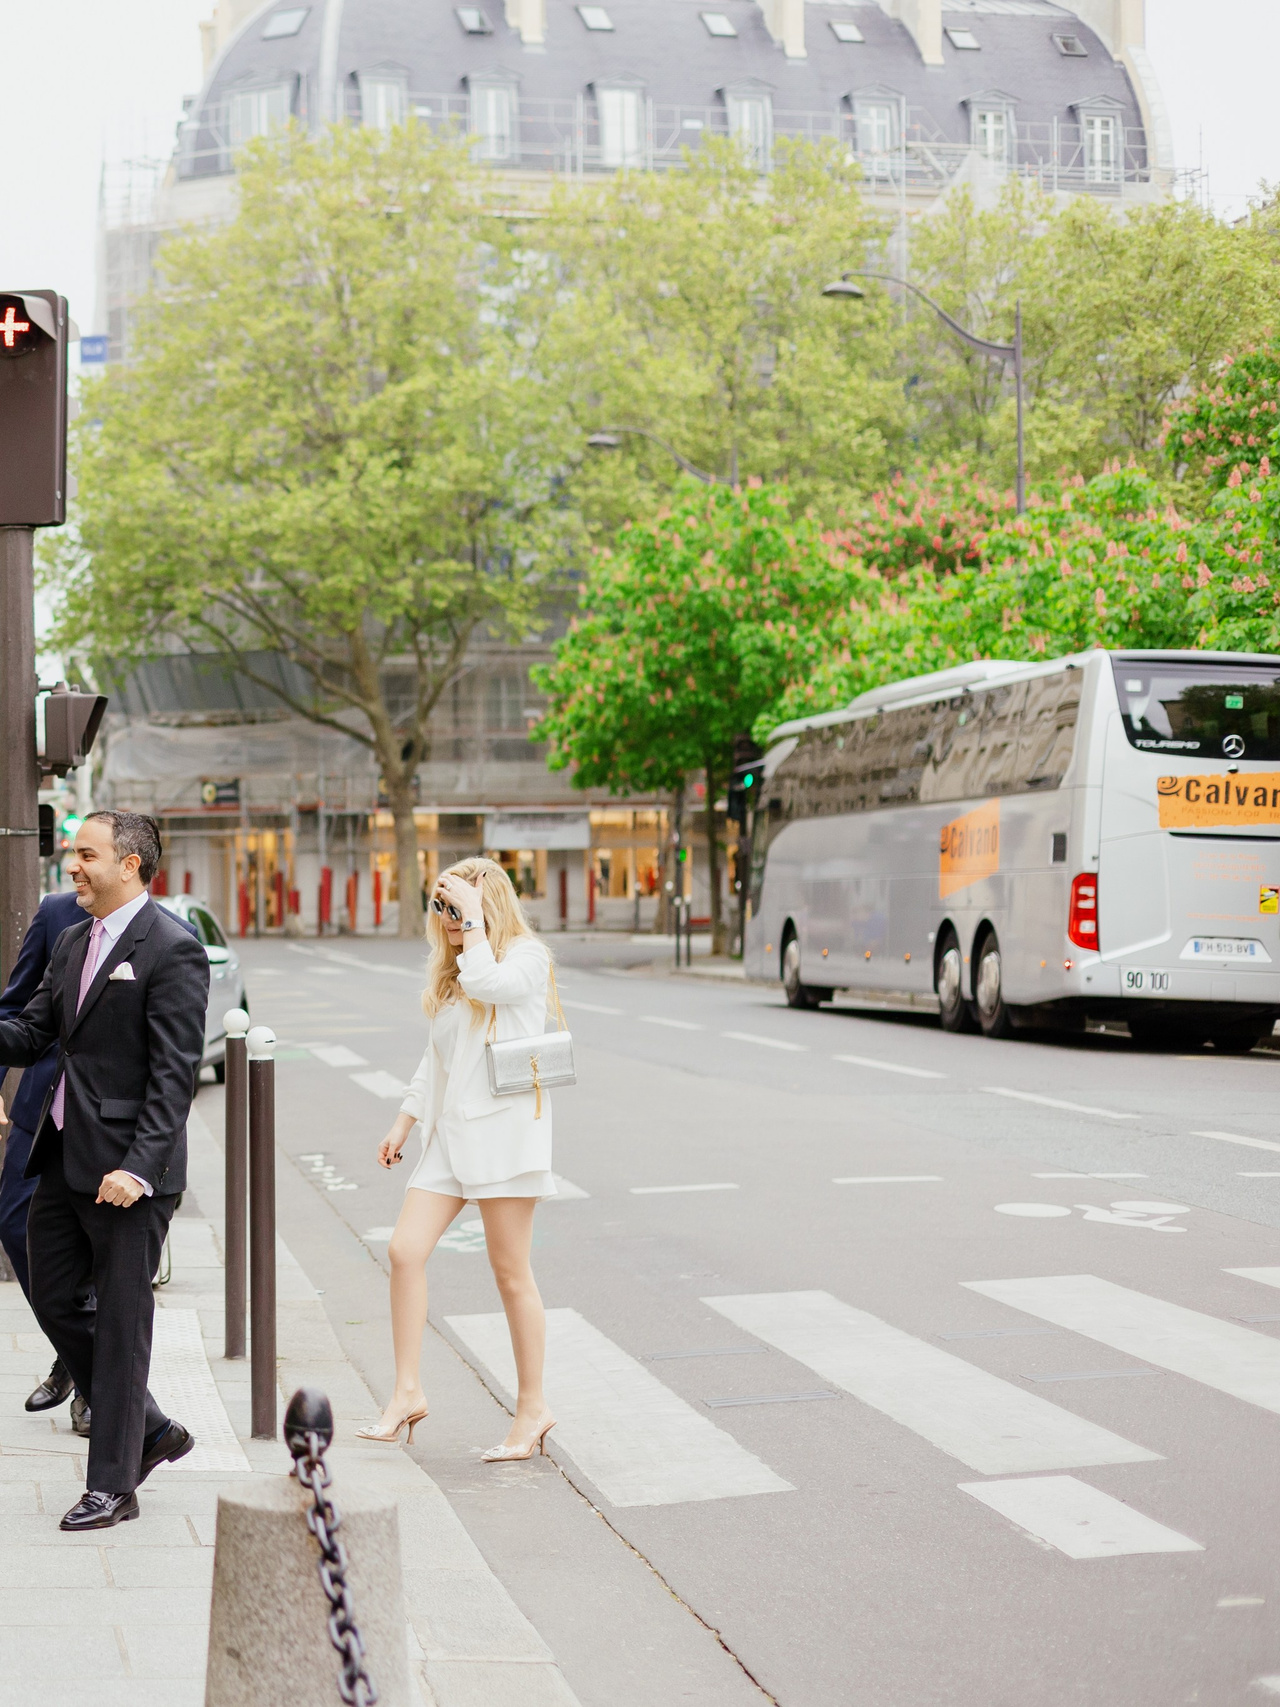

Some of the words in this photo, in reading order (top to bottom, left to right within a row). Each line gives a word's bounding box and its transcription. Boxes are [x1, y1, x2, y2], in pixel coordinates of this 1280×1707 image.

[1237, 809, 1260, 817] FOR
[950, 825, 998, 858] Calvano
[1127, 972, 1143, 989] 90
[1151, 973, 1169, 991] 100
